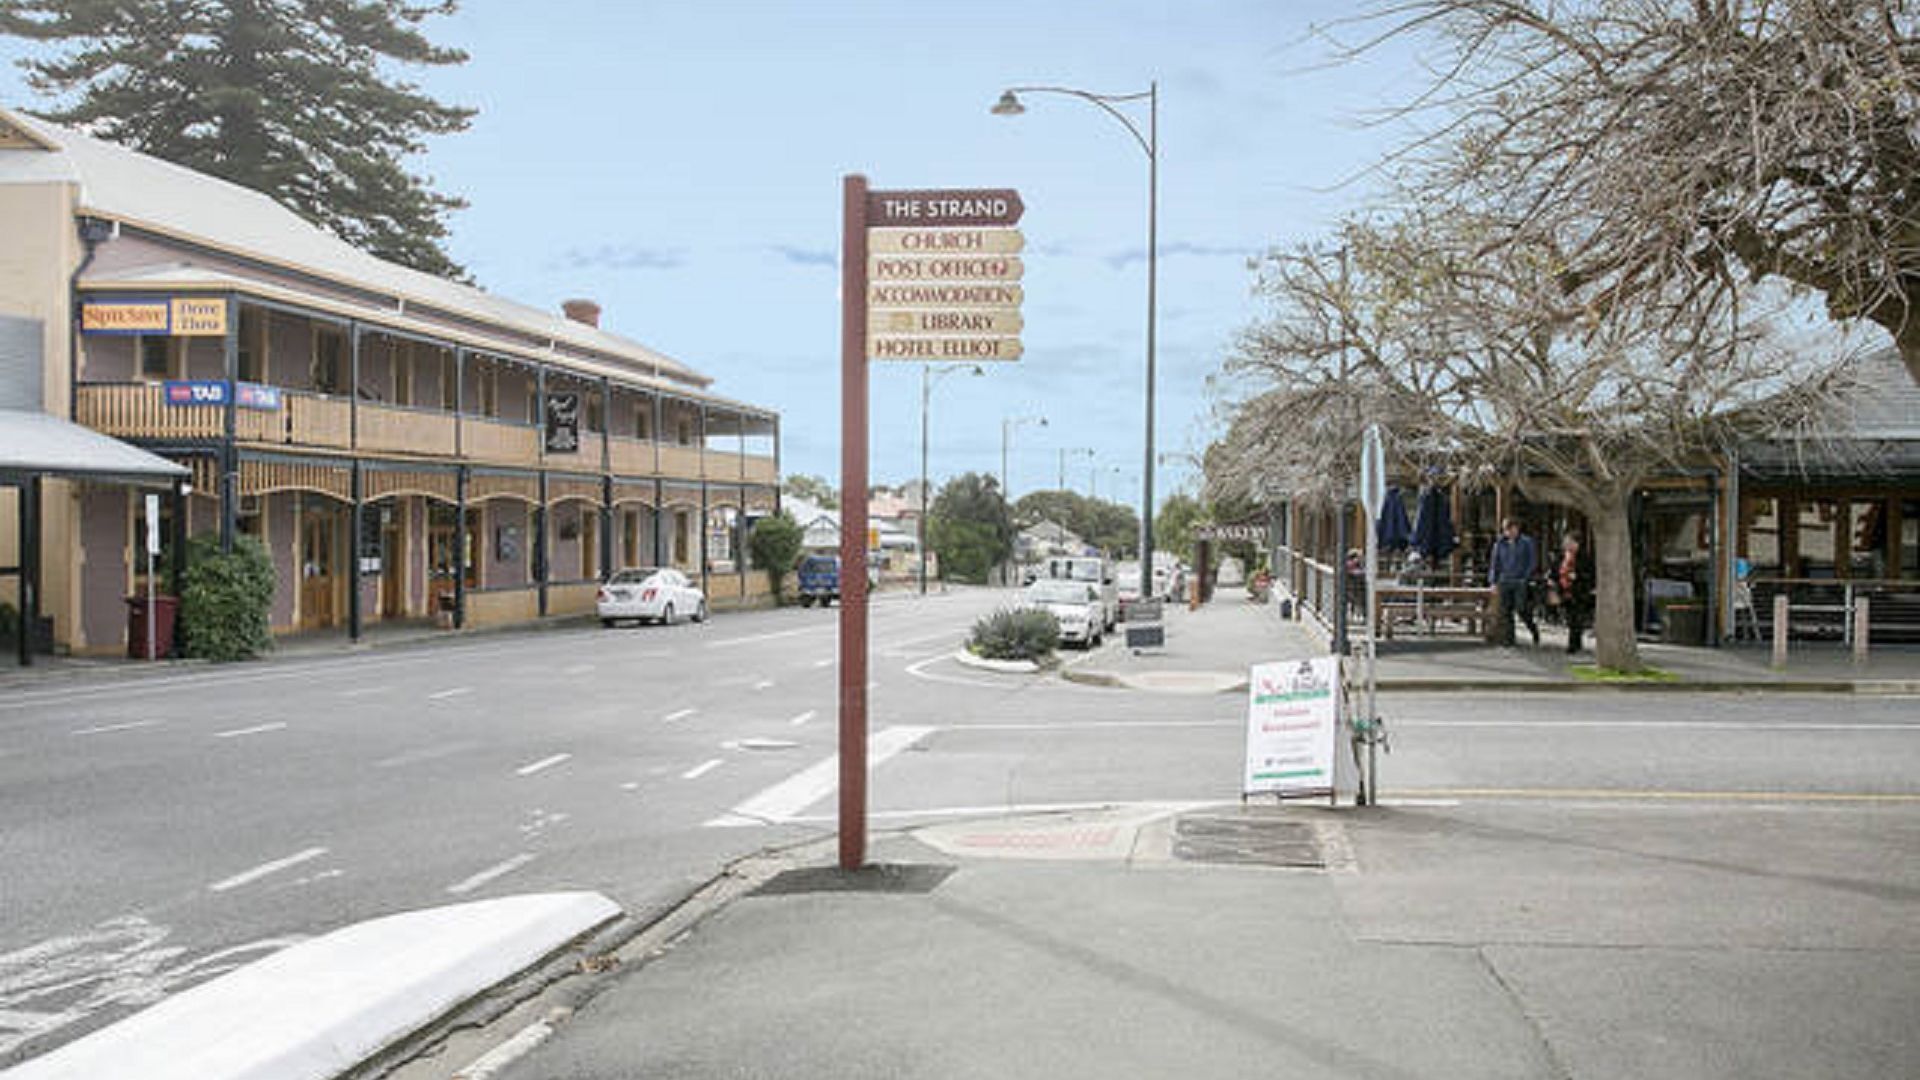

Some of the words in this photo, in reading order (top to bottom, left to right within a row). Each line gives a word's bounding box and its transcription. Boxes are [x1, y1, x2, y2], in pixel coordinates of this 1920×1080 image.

[883, 200, 921, 217] THE
[927, 199, 1007, 217] STRAND
[901, 232, 982, 249] CHURCH
[877, 260, 922, 276] POST
[928, 259, 987, 277] OFFICE
[872, 286, 1014, 303] ACCOMMODATION
[921, 313, 995, 330] LIBRARY
[876, 340, 933, 357] HOTEL
[942, 339, 1000, 356] ELLIOT
[192, 384, 222, 401] TAB
